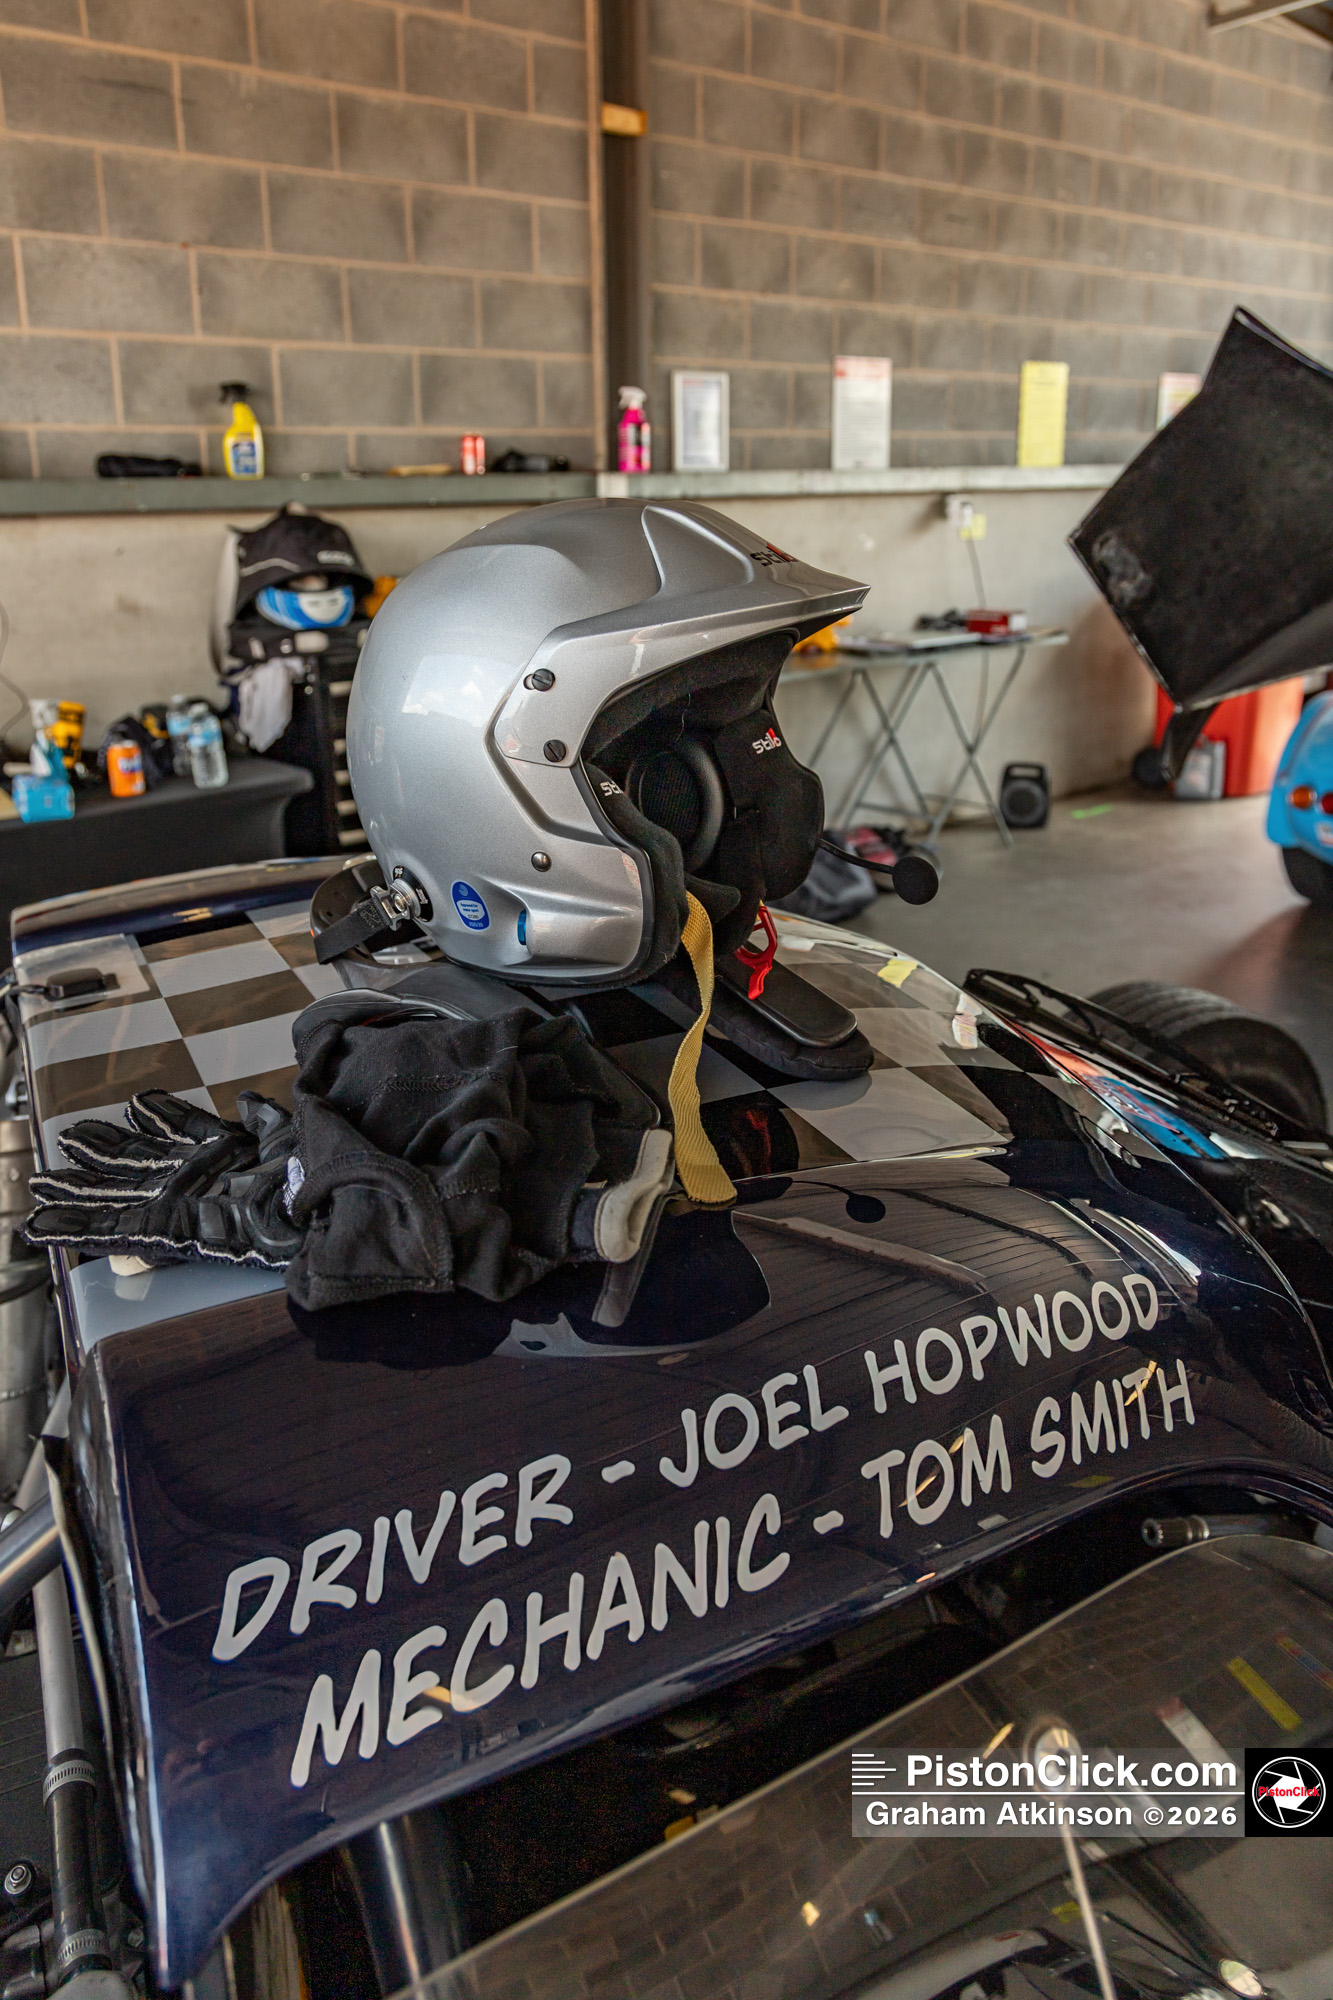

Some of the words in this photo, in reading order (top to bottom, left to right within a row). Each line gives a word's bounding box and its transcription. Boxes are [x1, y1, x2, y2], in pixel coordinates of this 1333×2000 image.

[211, 1454, 574, 1662] DRIVER
[659, 1364, 850, 1488] JOEL
[863, 1273, 1159, 1414] HOPWOOD
[290, 1493, 791, 1788] MECHANIC
[860, 1414, 1013, 1539] TOM
[1030, 1358, 1196, 1479] SMITH
